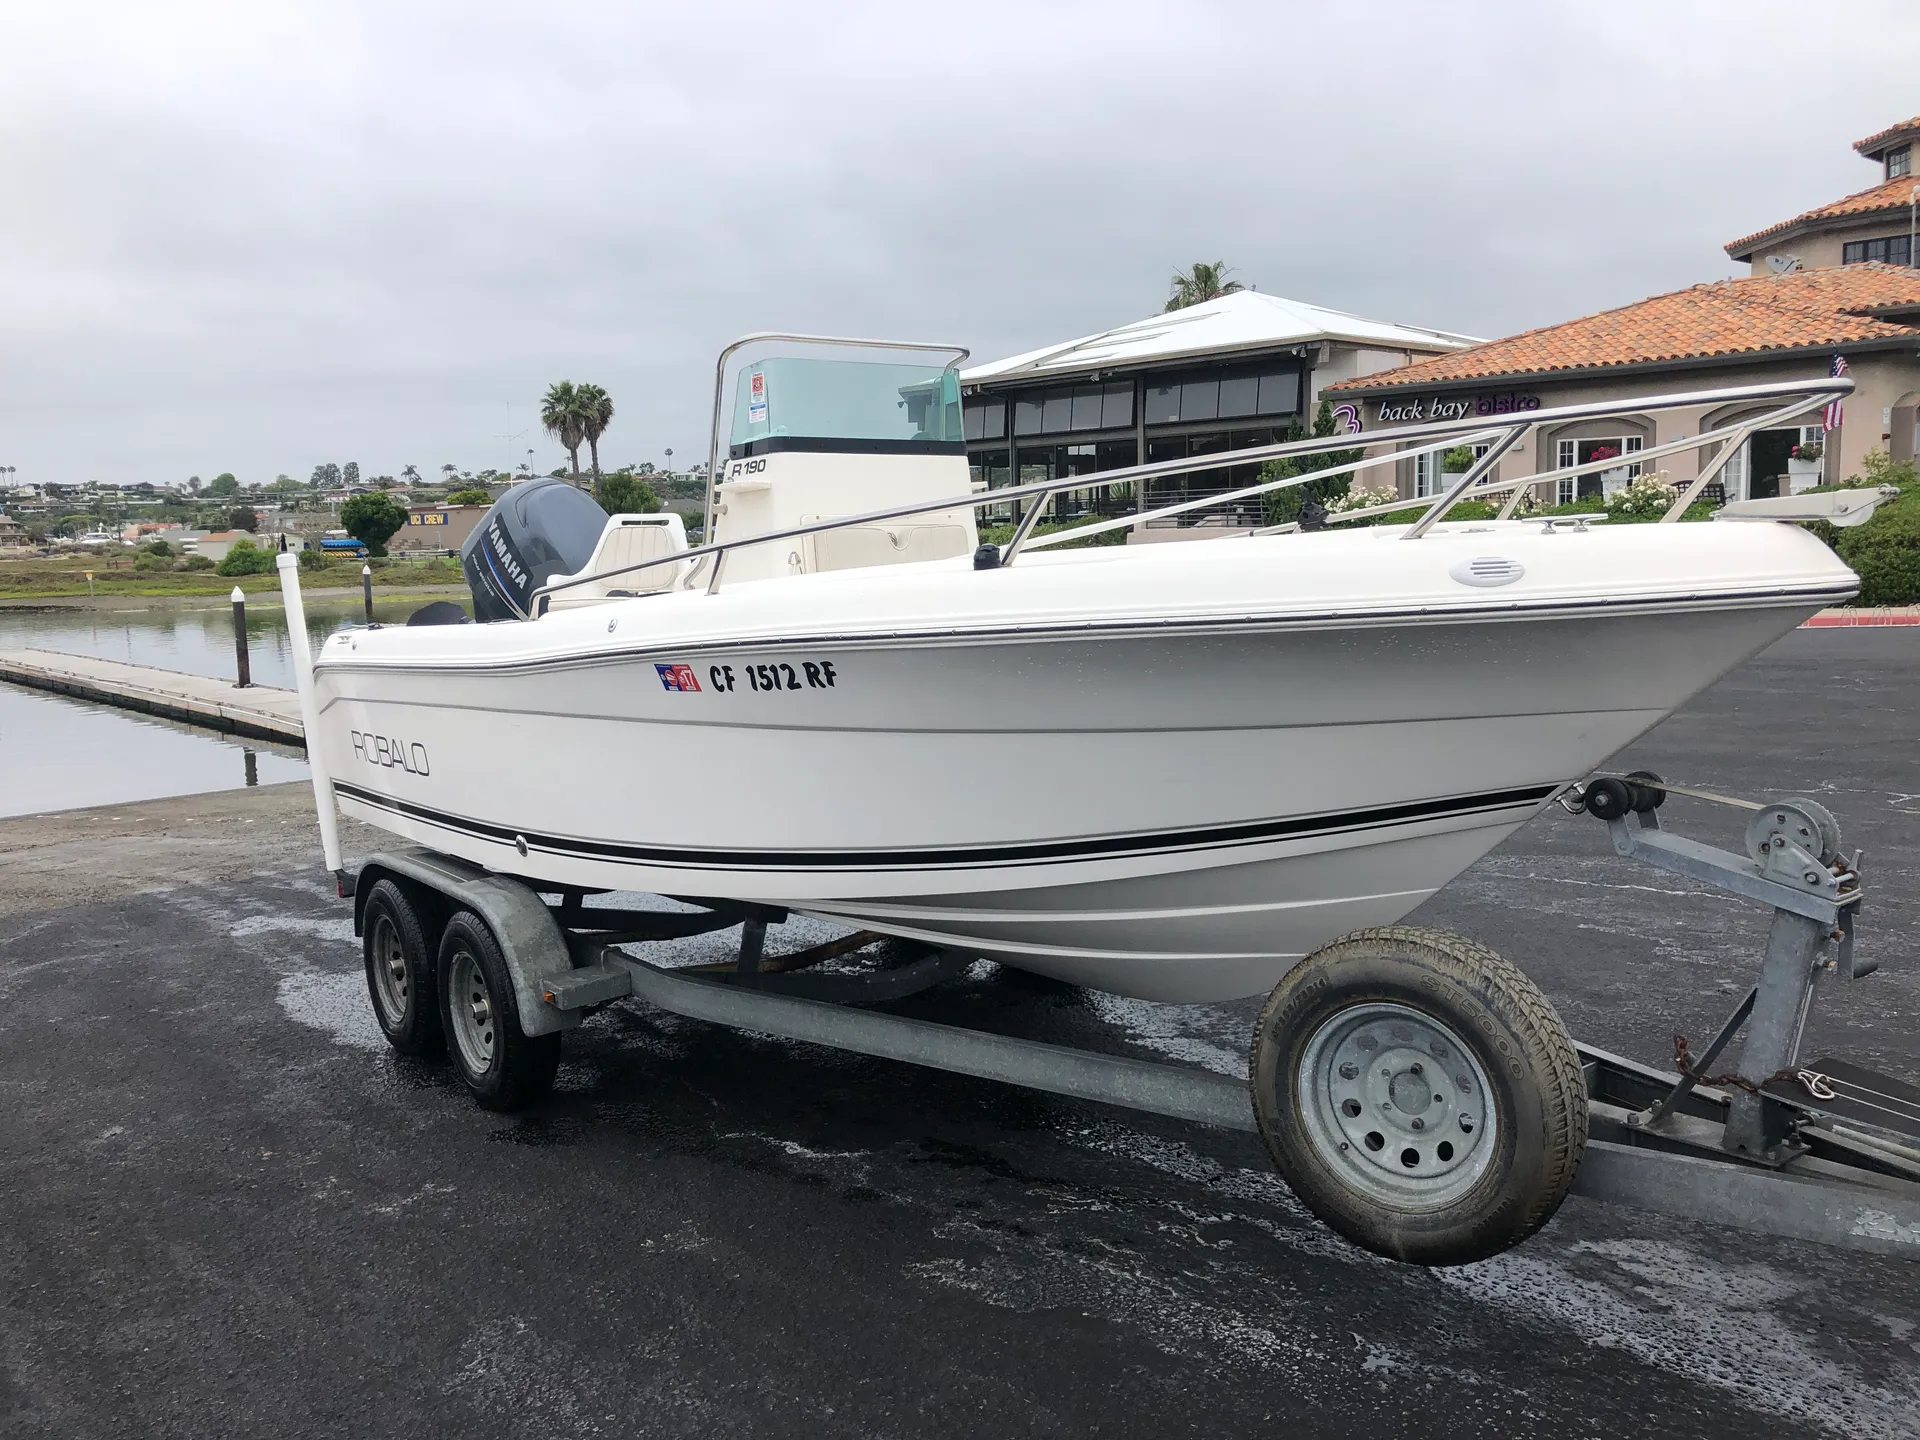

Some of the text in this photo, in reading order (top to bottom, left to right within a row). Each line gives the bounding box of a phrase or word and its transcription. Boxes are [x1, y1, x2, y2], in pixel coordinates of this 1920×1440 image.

[1378, 392, 1540, 421] back bay bistro
[731, 459, 766, 477] R 190
[410, 514, 444, 525] UCI CREW
[488, 517, 527, 589] YAMAHA
[710, 661, 837, 692] CF 1512 RF
[351, 729, 430, 777] ROBALO
[1420, 974, 1525, 1080] ST5000
